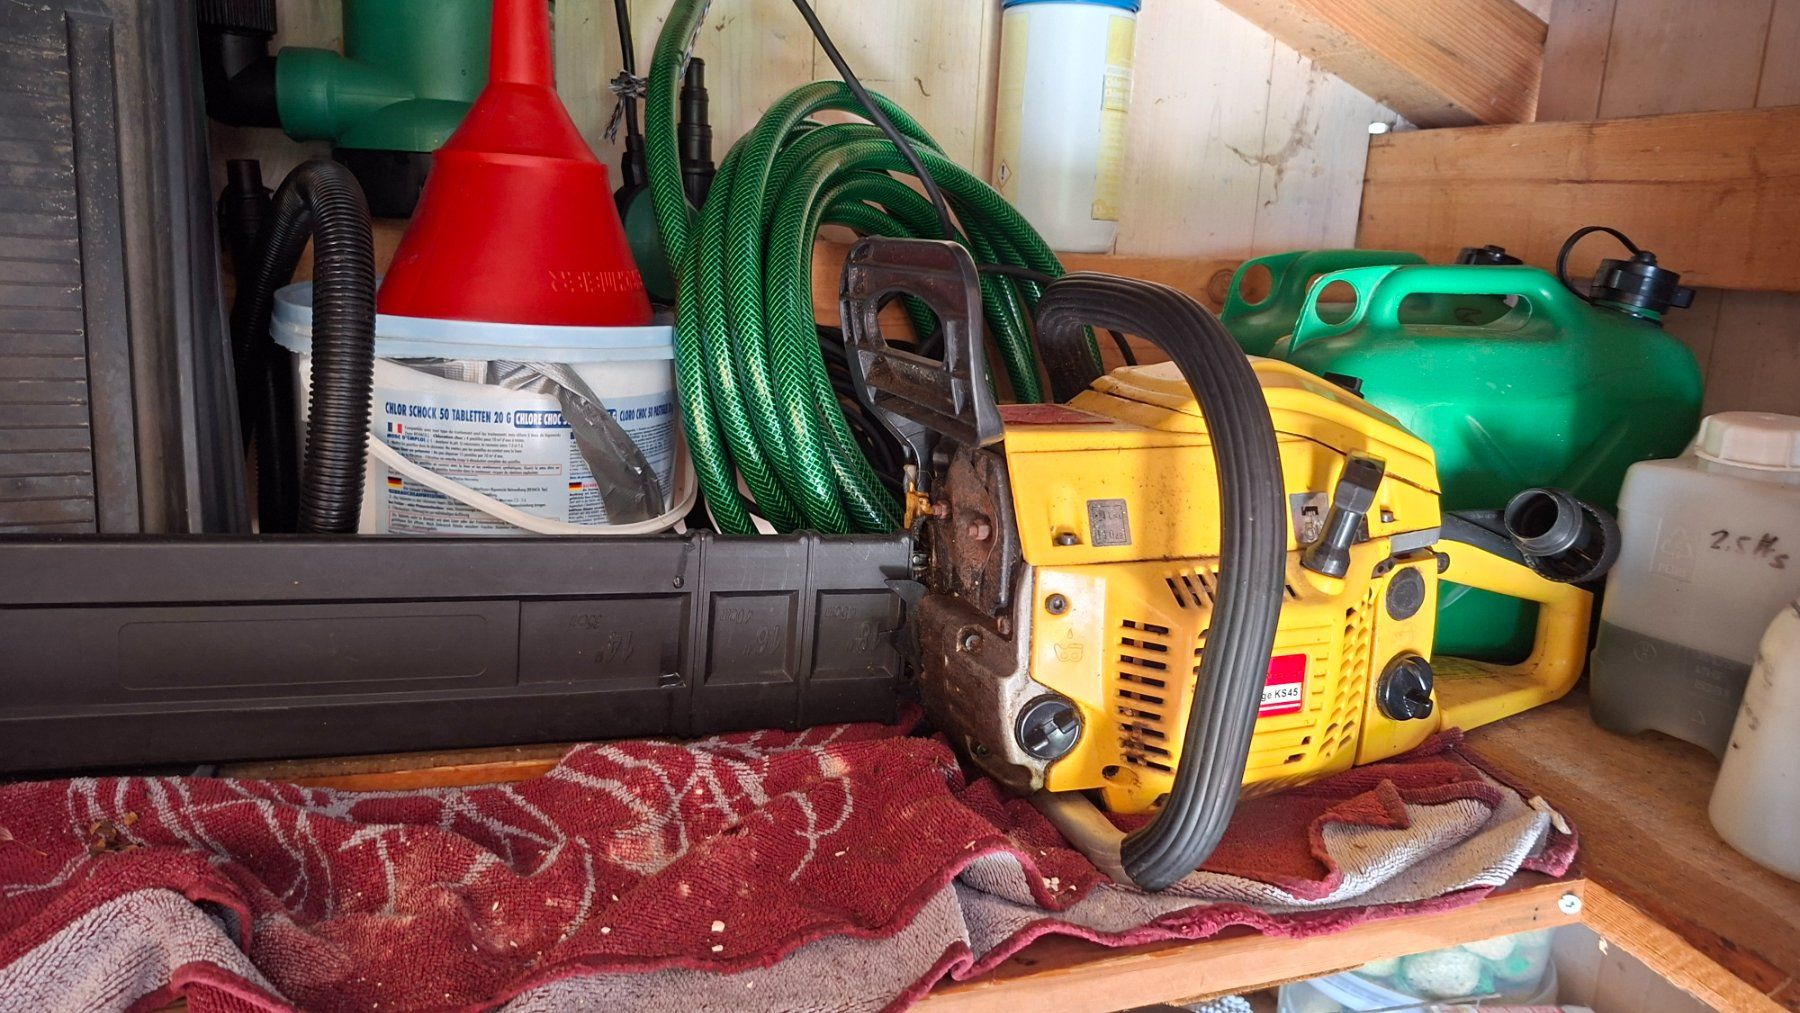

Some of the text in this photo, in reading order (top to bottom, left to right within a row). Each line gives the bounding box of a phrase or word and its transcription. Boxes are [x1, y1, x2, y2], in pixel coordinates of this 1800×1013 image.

[385, 401, 512, 424] CHLOR SCHOCK 50 TABLETTEN 20 G
[515, 412, 542, 425] CHLORE
[544, 412, 562, 425] CHOC
[1274, 687, 1299, 699] KS45
